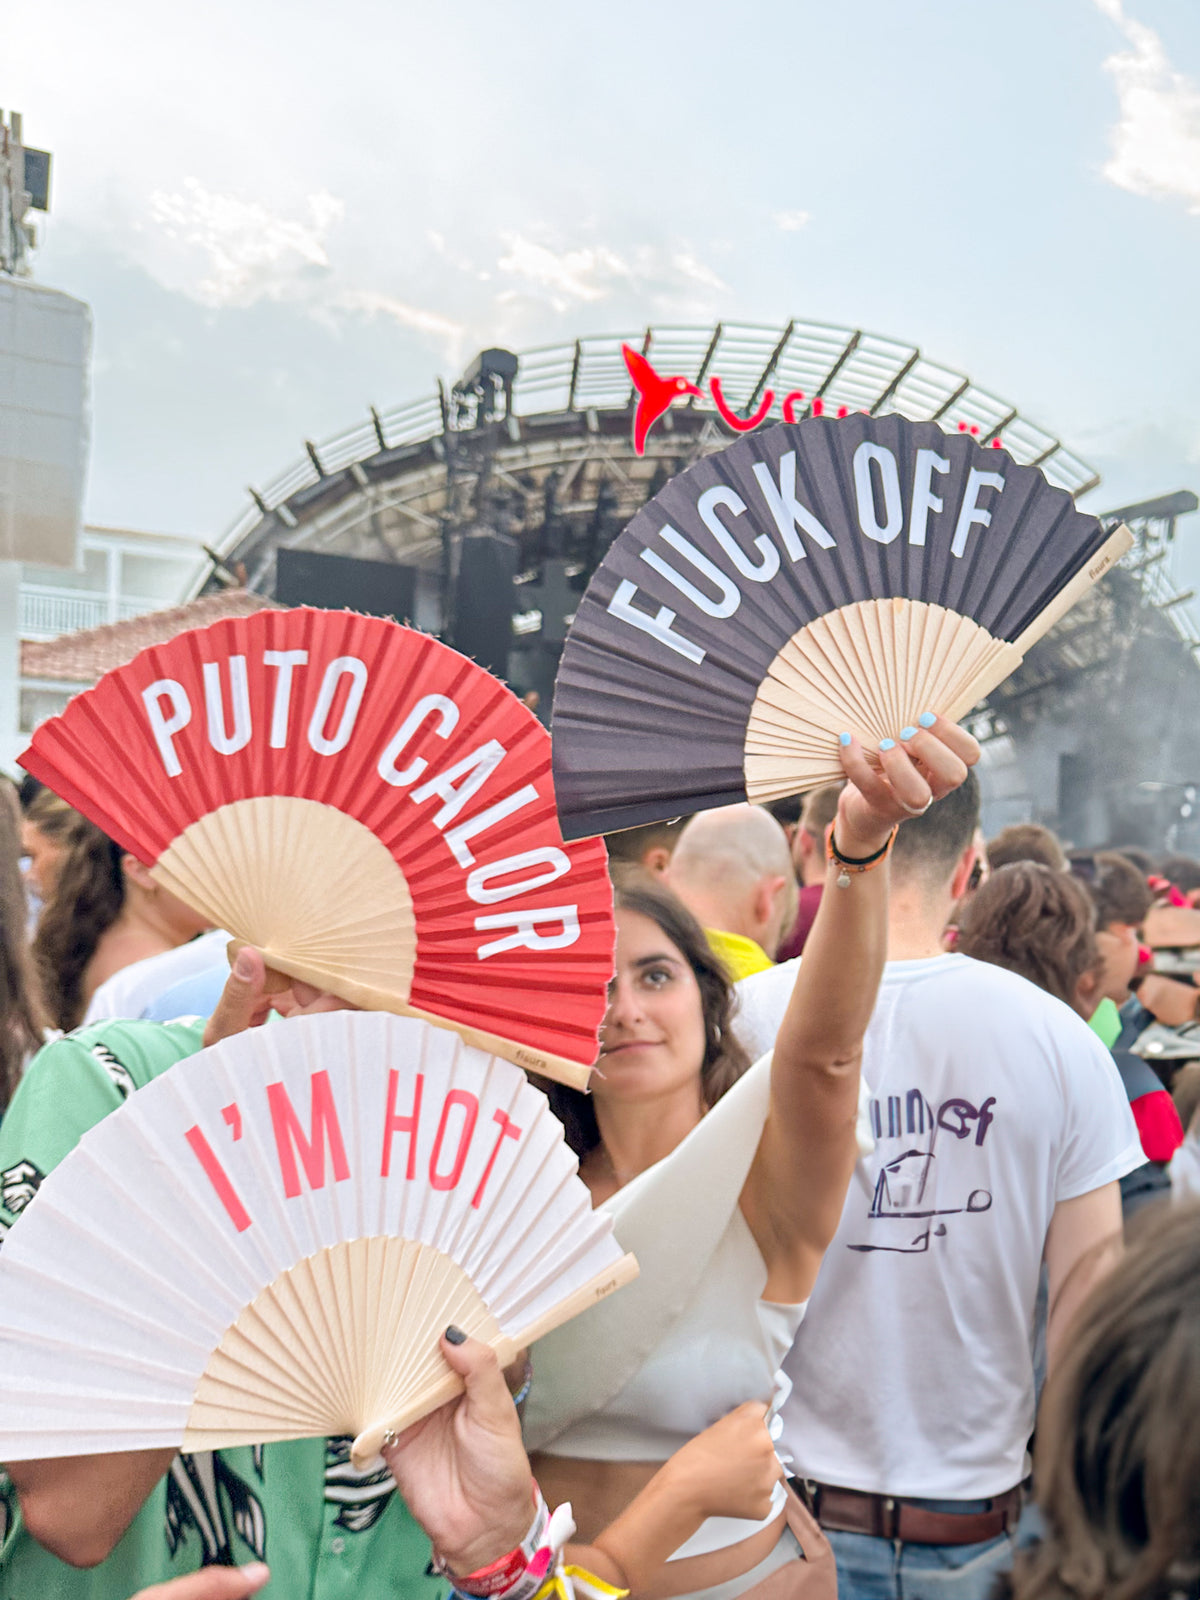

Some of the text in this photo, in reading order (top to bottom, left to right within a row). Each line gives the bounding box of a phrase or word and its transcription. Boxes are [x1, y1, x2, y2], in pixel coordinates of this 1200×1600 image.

[607, 441, 1005, 665] FUCK OFF
[142, 650, 581, 960] PUTO CALOR
[184, 1069, 523, 1233] I'M HOT
